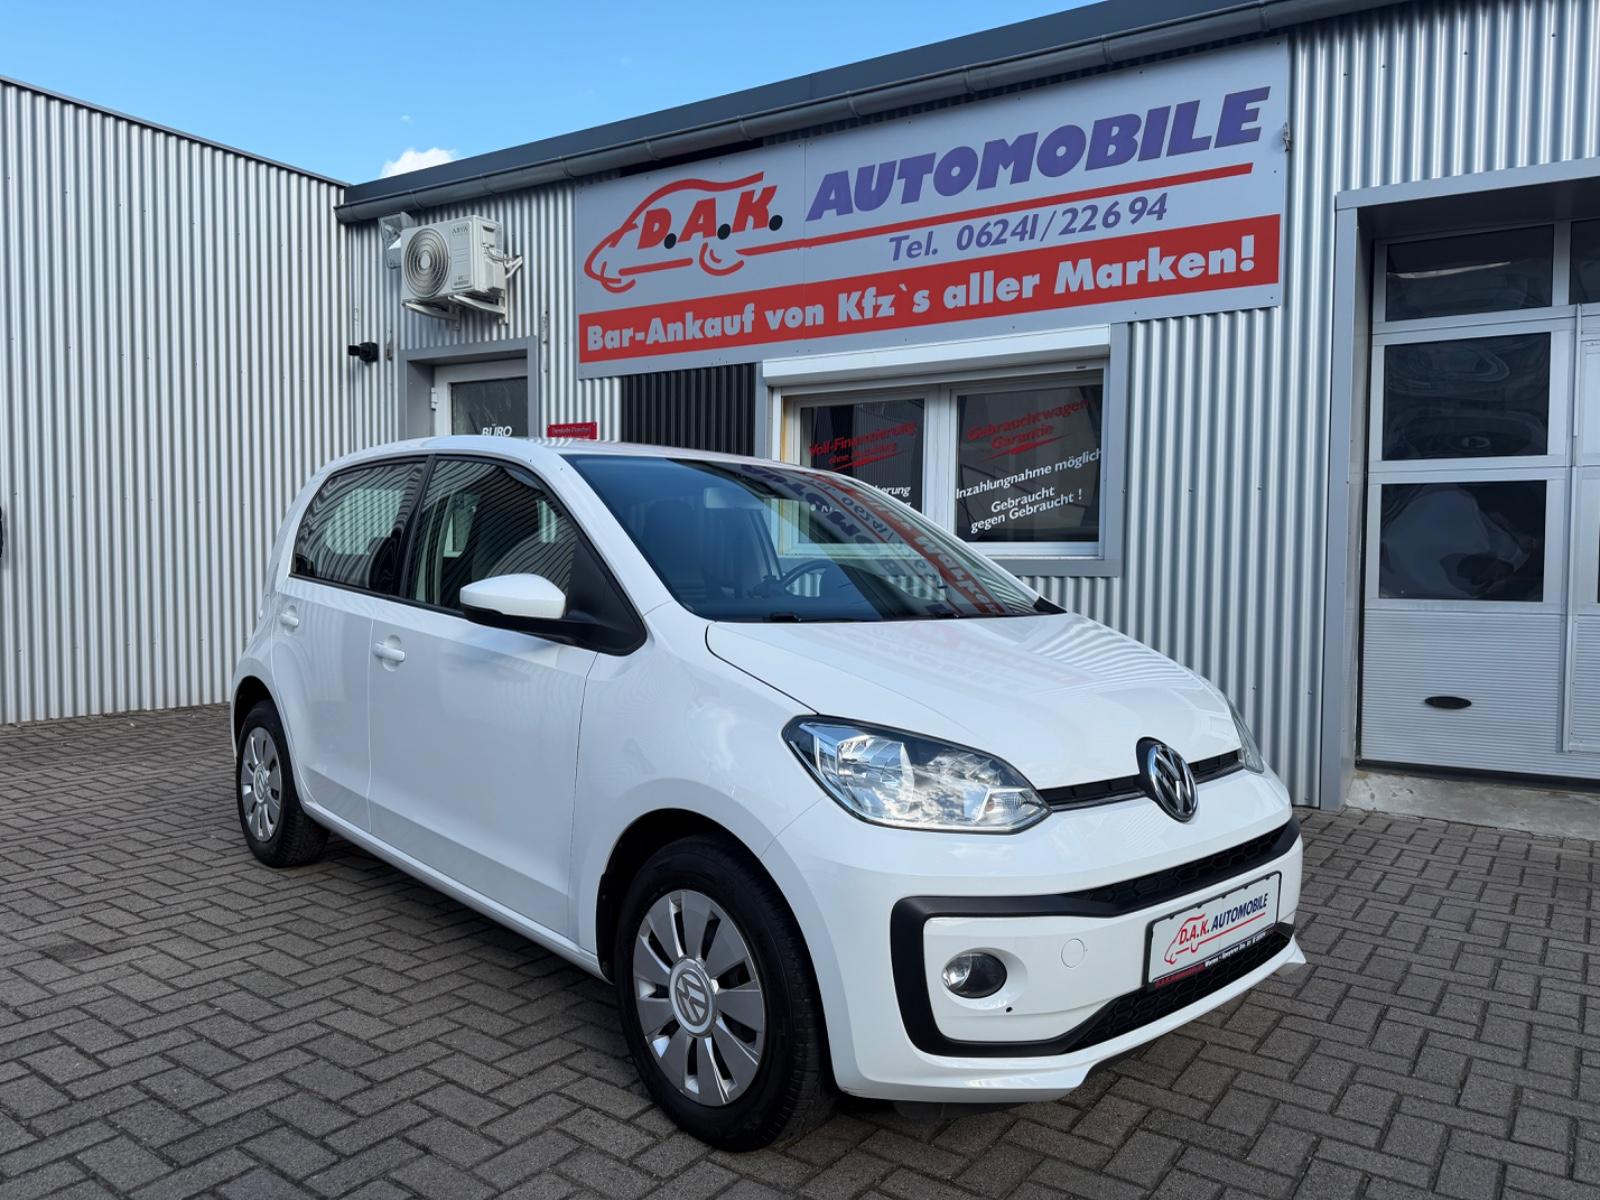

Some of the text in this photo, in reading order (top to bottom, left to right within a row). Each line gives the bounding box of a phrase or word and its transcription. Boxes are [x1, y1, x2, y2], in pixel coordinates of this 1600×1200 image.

[637, 86, 1271, 250] D.A.K. AUTOMOBILE
[888, 230, 938, 262] Tel.
[587, 303, 755, 352] Bar-Ankauf
[764, 303, 824, 331] von
[942, 271, 1041, 310] aller
[1053, 233, 1255, 295] Marken!
[481, 423, 513, 437] BÜRO
[955, 464, 1052, 500] Inzahlungnahme
[990, 486, 1056, 513] Gebraucht
[970, 513, 1006, 535] gegen
[1008, 492, 1075, 520] Gebraucht
[1179, 892, 1269, 945] D.A.K. AUTOMOBILE
